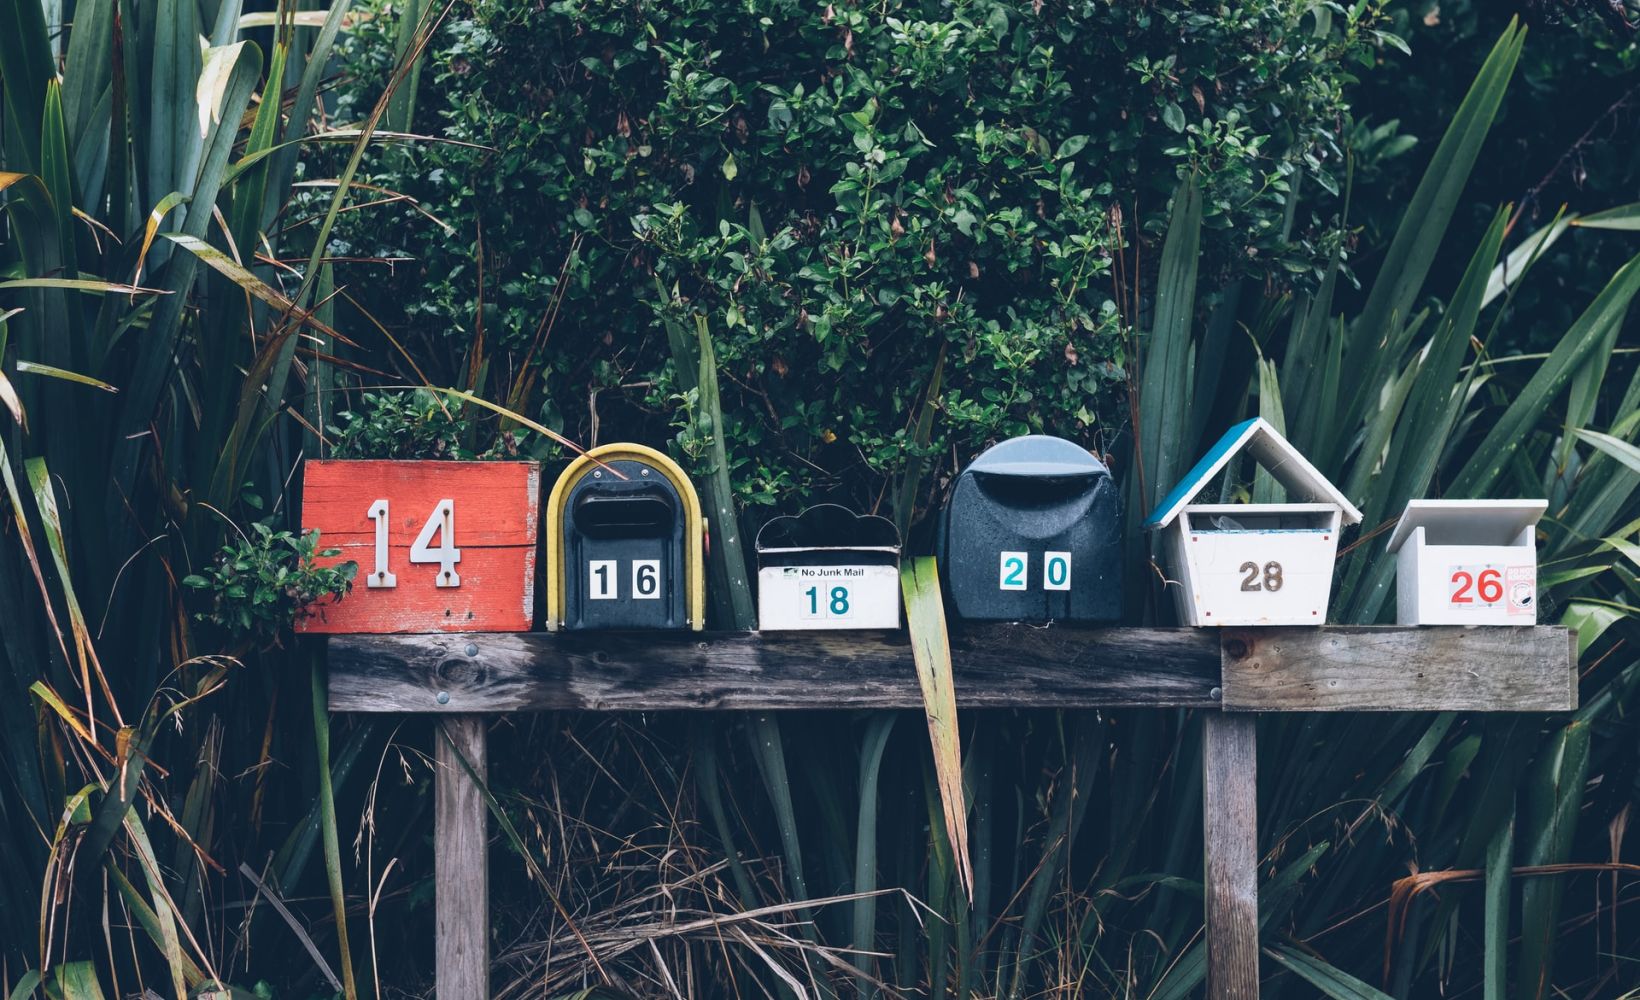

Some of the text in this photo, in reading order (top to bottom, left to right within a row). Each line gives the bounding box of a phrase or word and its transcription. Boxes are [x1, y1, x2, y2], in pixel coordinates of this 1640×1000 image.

[367, 499, 461, 588] 14
[594, 564, 657, 596] 16
[801, 568, 864, 577] No Junk Mail
[1003, 557, 1067, 586] 20
[1239, 561, 1284, 592] 28
[1452, 570, 1504, 603] 26
[805, 586, 849, 615] 18
